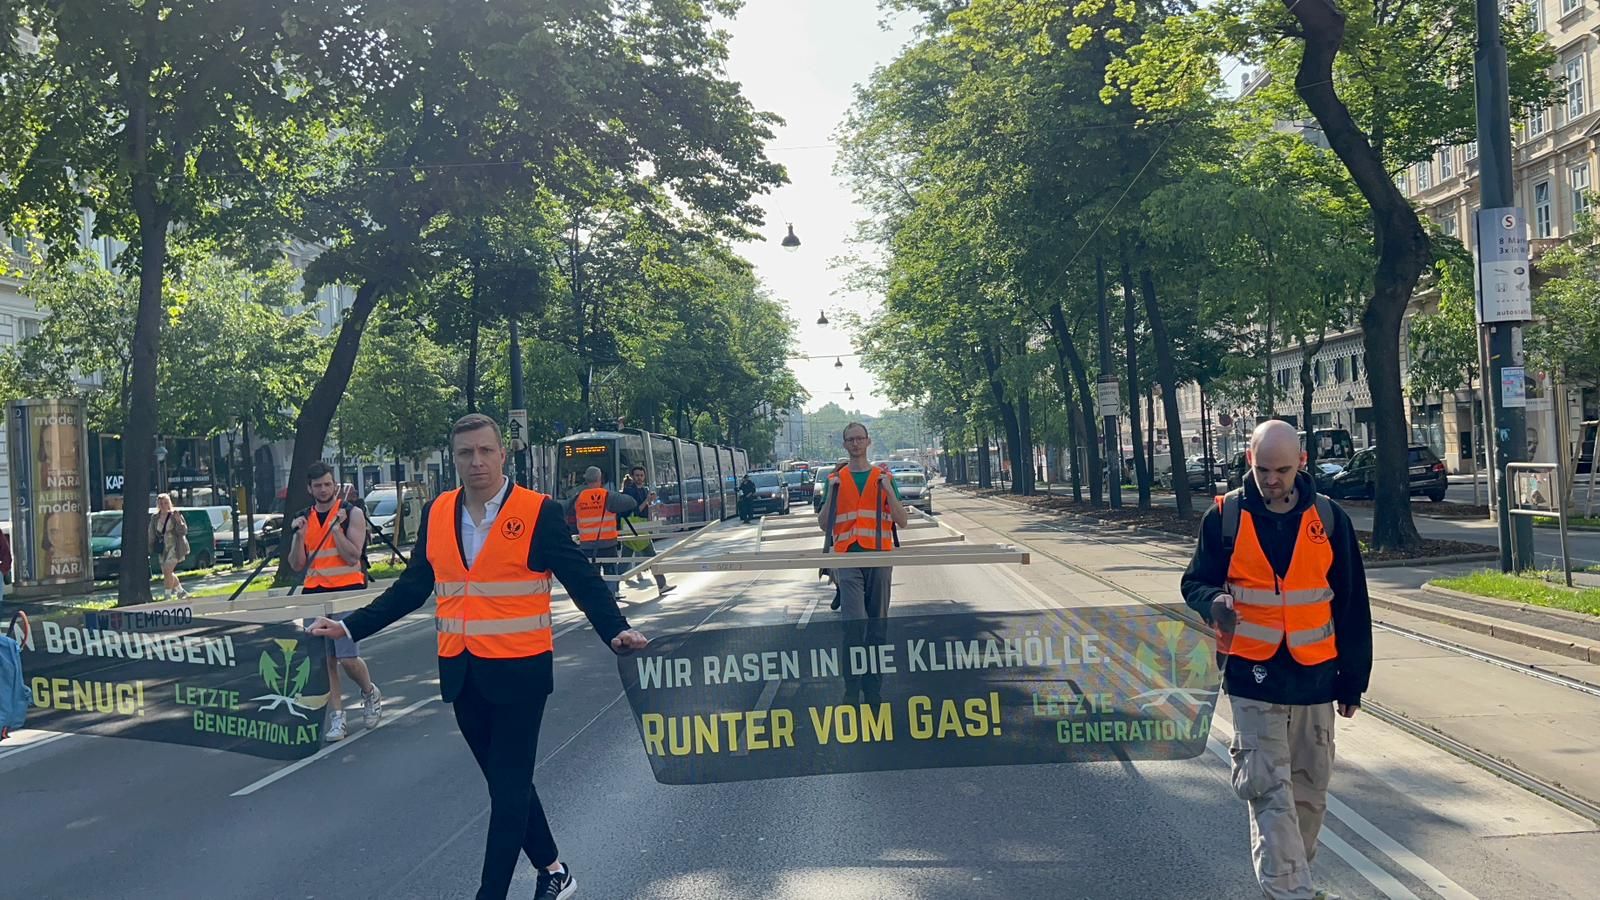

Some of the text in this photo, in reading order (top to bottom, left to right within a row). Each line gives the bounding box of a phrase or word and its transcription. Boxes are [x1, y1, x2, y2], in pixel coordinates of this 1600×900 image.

[1499, 237, 1505, 245] 8
[1499, 246, 1509, 255] 3x
[42, 621, 236, 667] BOHRUNGEN!
[637, 630, 1111, 690] WIR RASEN IN DIE KLIMAHÖLLE.
[31, 676, 145, 717] GENUG!
[175, 683, 240, 711] LETZTE
[1032, 692, 1113, 717] LETZTE
[193, 710, 319, 745] GENERATION.AT
[641, 692, 1002, 757] RUNTER VOM GAS!
